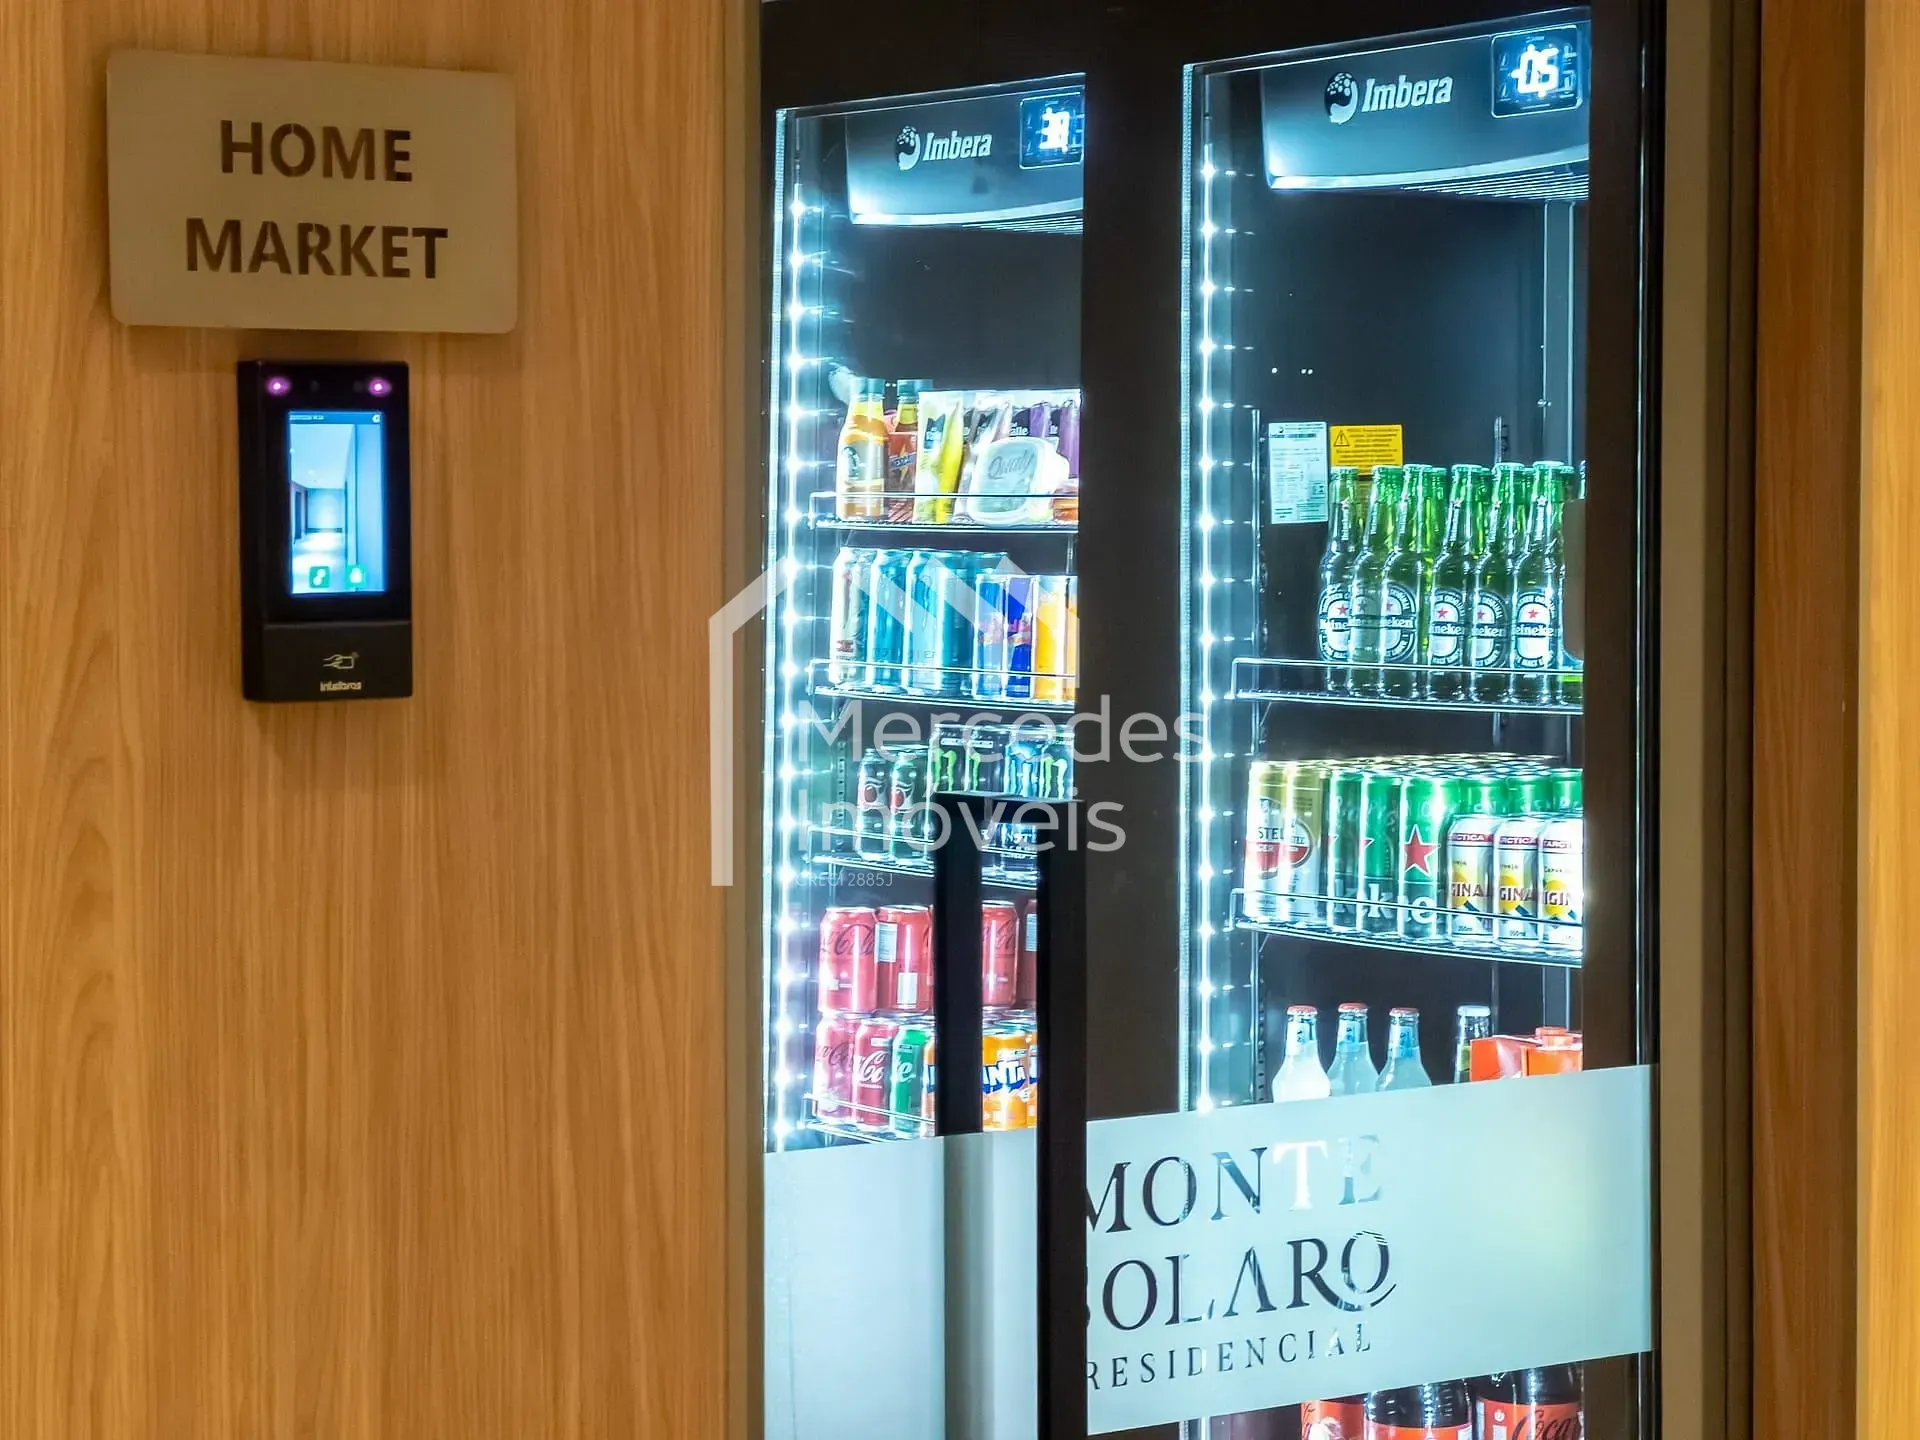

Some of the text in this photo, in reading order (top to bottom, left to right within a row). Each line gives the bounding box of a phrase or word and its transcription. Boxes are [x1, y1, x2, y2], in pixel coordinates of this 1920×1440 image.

[1361, 75, 1453, 112] Imbera
[219, 119, 413, 183] HOME
[923, 130, 992, 161] Imbera
[185, 216, 449, 280] MARKET
[1086, 1229, 1397, 1331] OLARO
[1086, 1323, 1371, 1390] RESIDENCIAL
